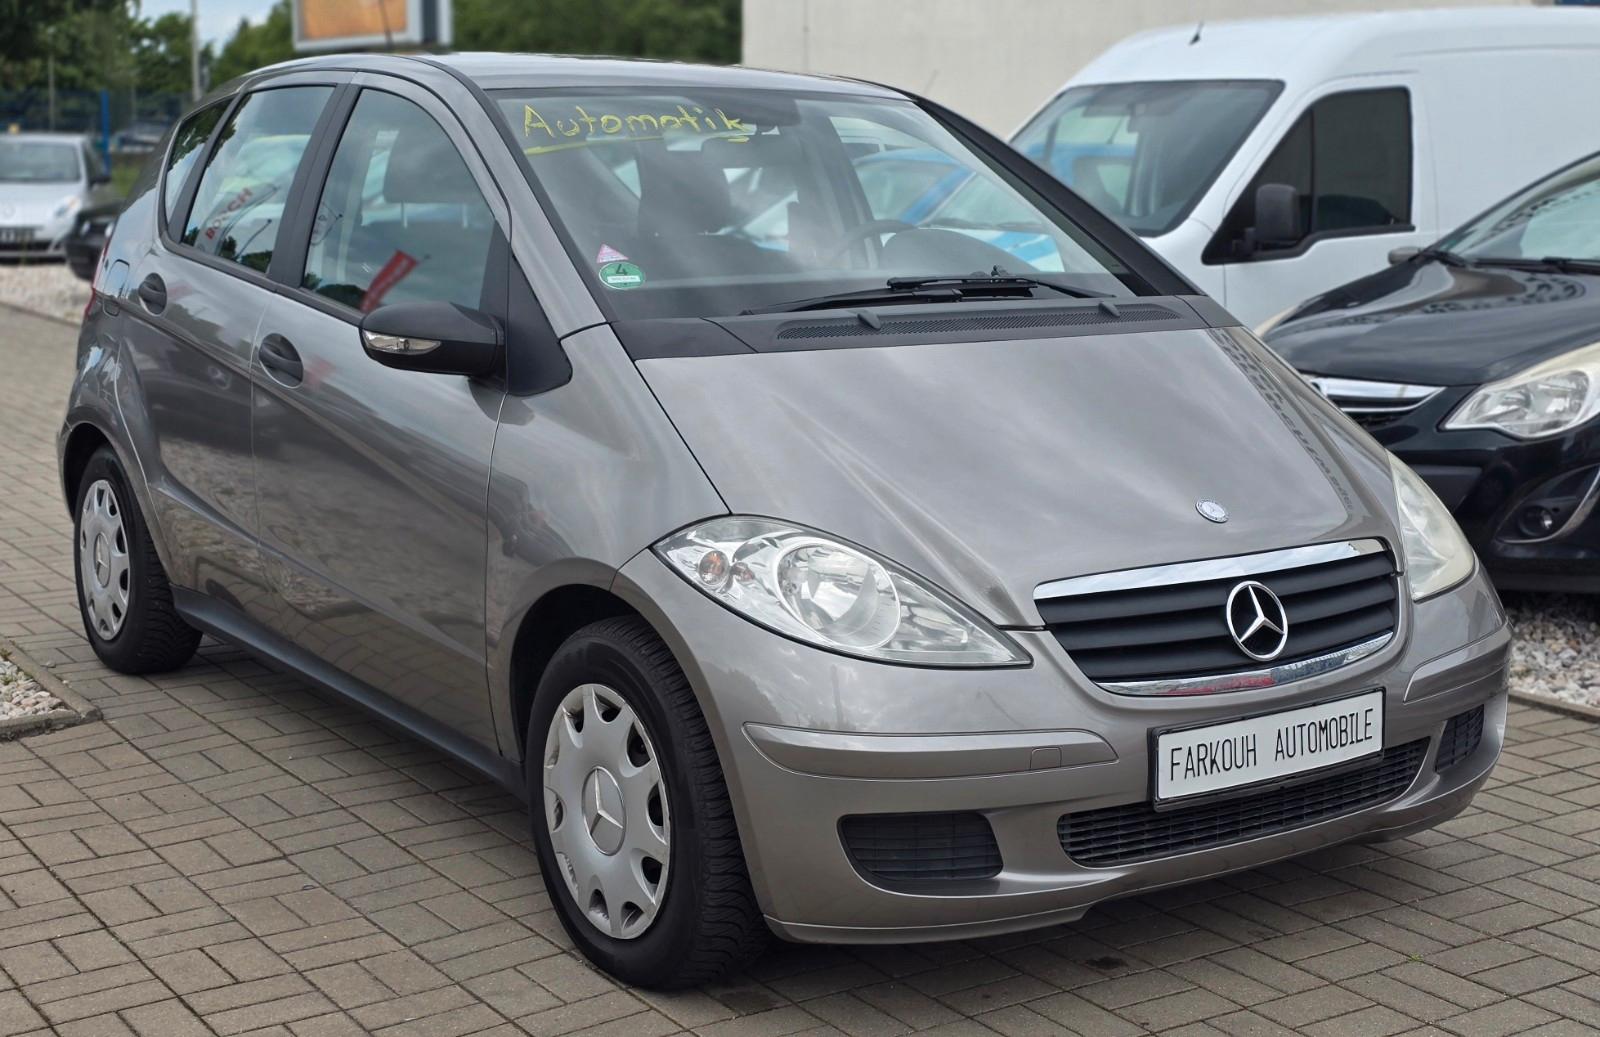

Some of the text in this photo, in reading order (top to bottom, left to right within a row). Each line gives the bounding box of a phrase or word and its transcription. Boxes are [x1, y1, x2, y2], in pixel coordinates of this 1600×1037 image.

[523, 104, 752, 138] Automatik
[615, 263, 629, 276] 4
[1170, 708, 1374, 781] FARKOUH AUTOMOBILE
